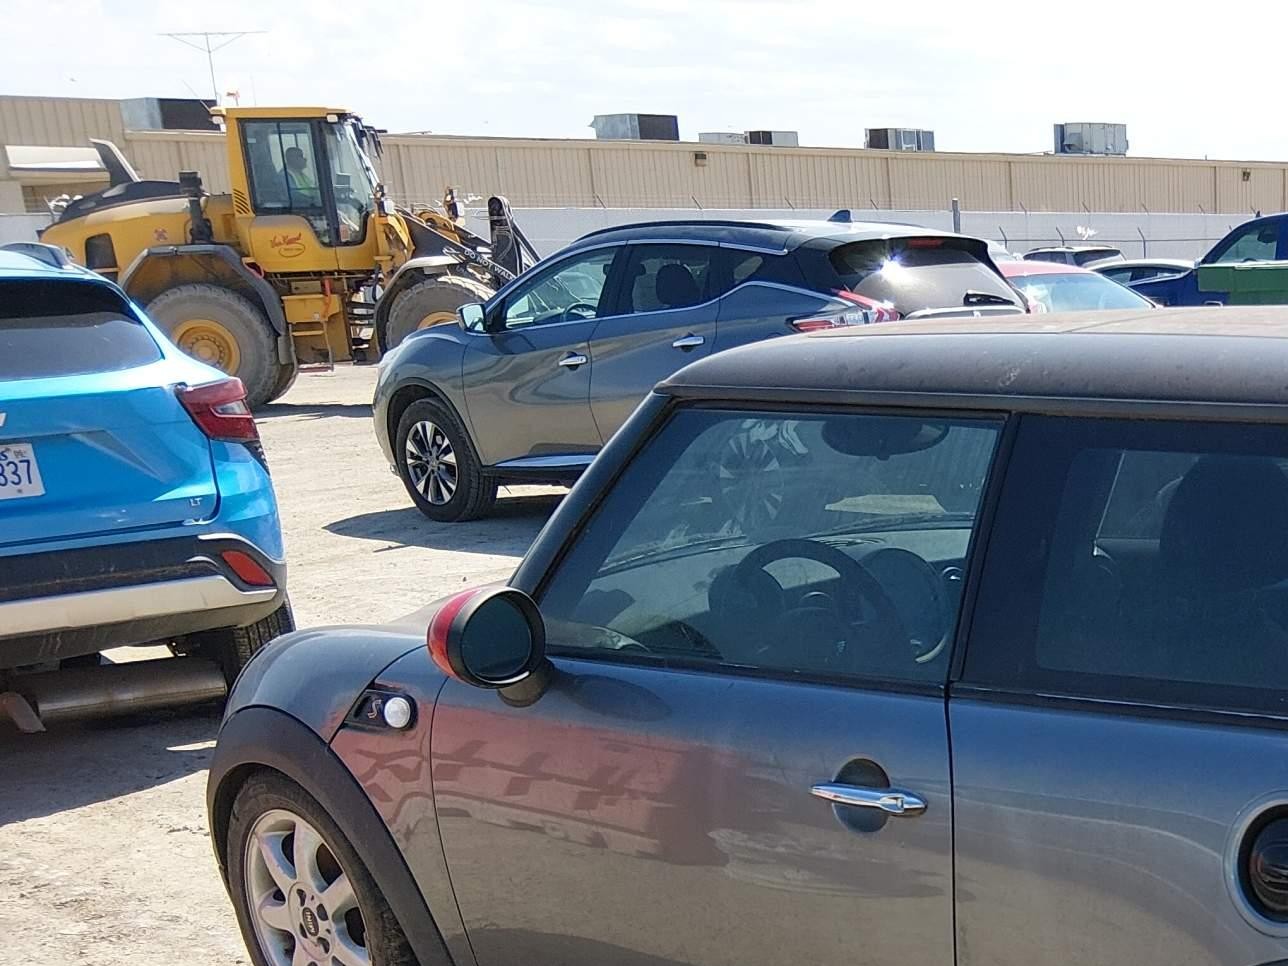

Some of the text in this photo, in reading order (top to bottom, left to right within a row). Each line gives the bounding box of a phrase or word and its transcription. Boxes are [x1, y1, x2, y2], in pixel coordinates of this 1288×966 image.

[464, 249, 476, 259] DO
[477, 256, 493, 271] NOT
[367, 699, 382, 719] S
